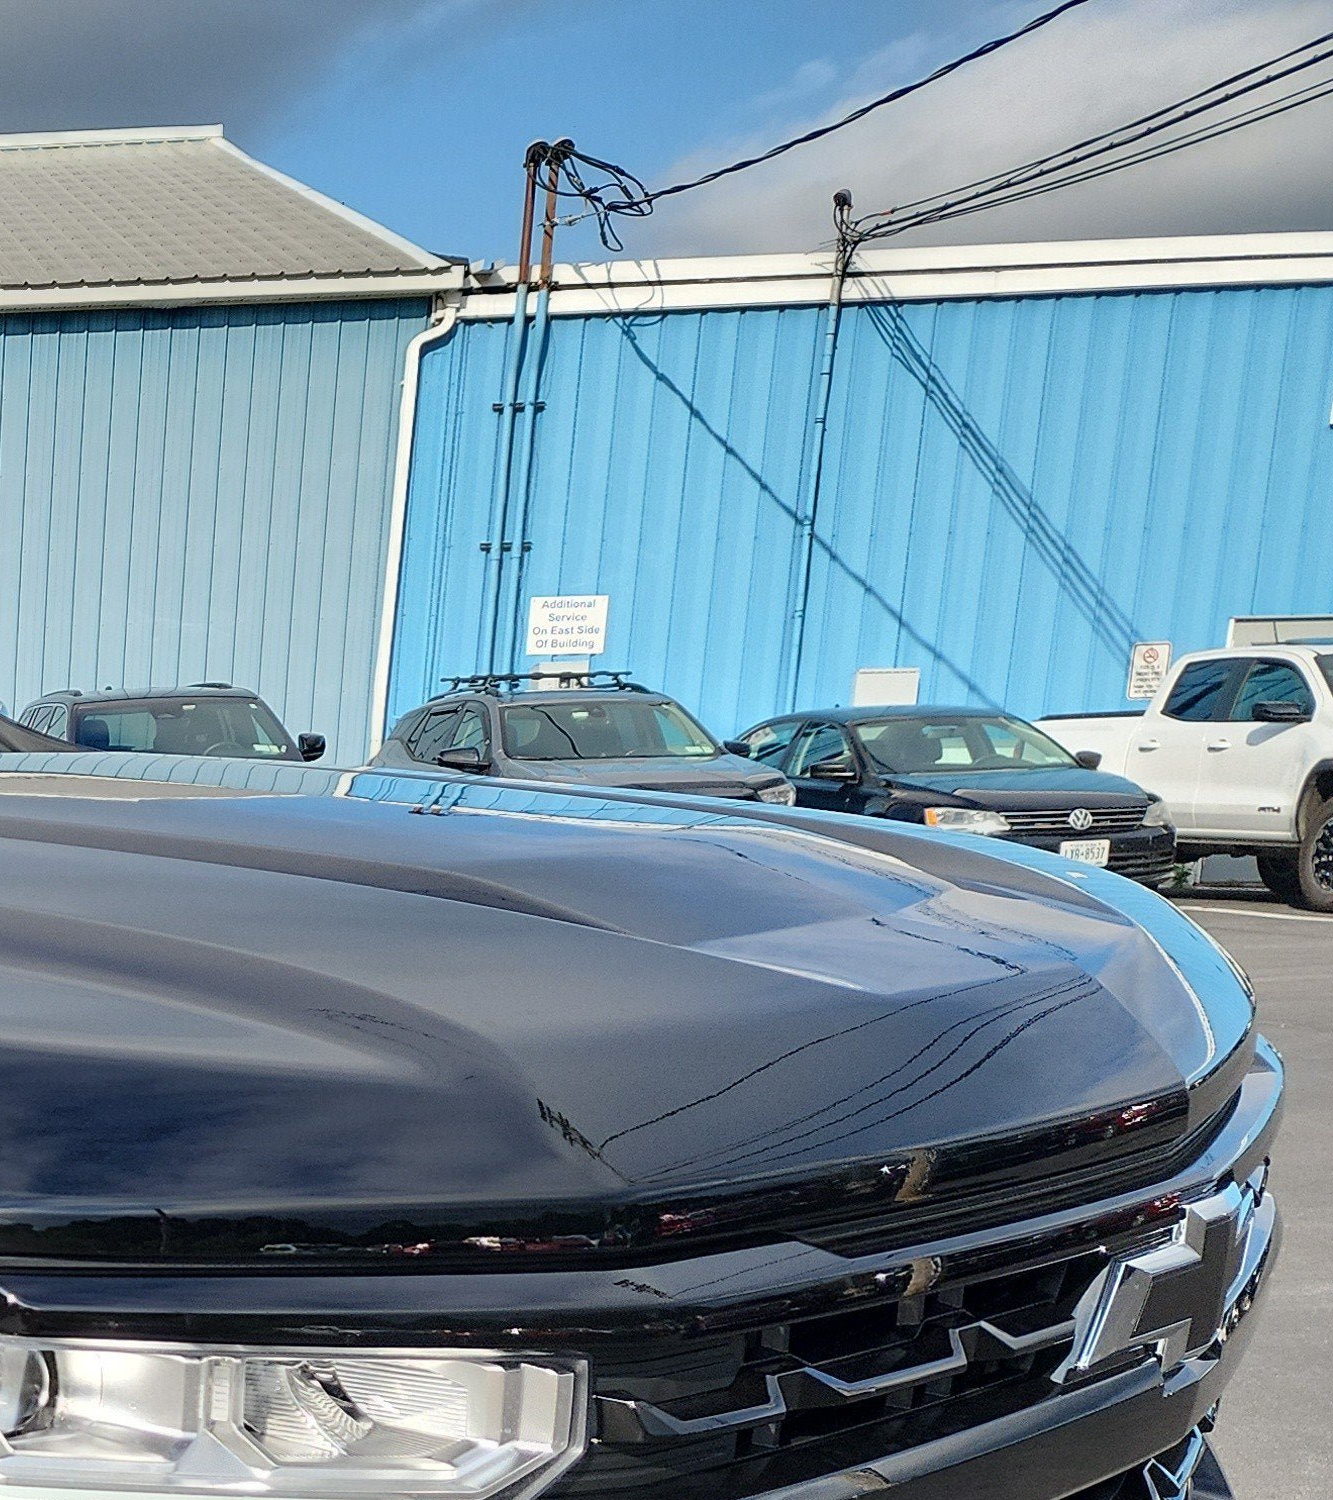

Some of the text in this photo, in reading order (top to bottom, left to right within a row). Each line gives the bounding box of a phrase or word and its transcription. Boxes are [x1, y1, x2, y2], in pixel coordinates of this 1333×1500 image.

[541, 599, 596, 609] Additional
[548, 613, 588, 622] Service
[532, 625, 600, 635] On East Side
[535, 638, 595, 650] Of Building
